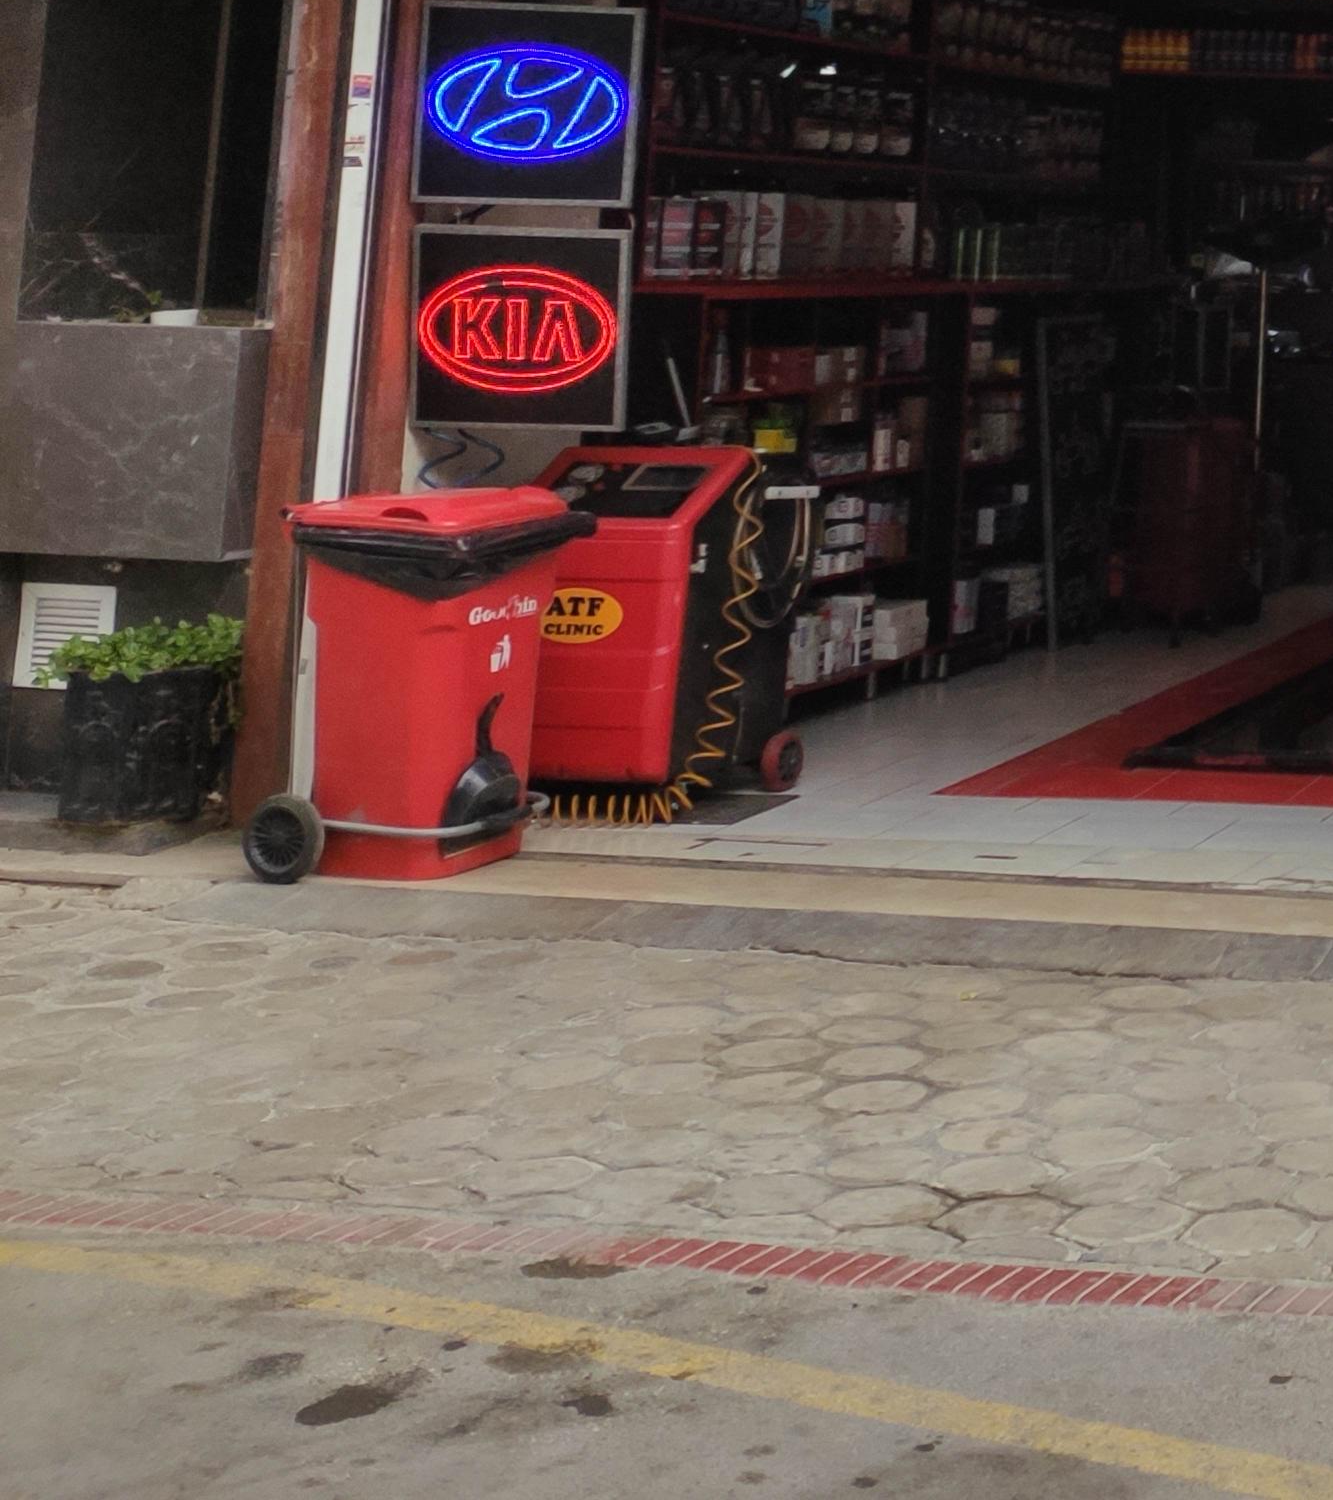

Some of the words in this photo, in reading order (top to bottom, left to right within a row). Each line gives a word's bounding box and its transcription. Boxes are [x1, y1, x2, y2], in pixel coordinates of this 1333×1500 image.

[453, 297, 584, 363] KIA
[546, 596, 605, 618] ATF
[543, 623, 604, 636] CLINIC
